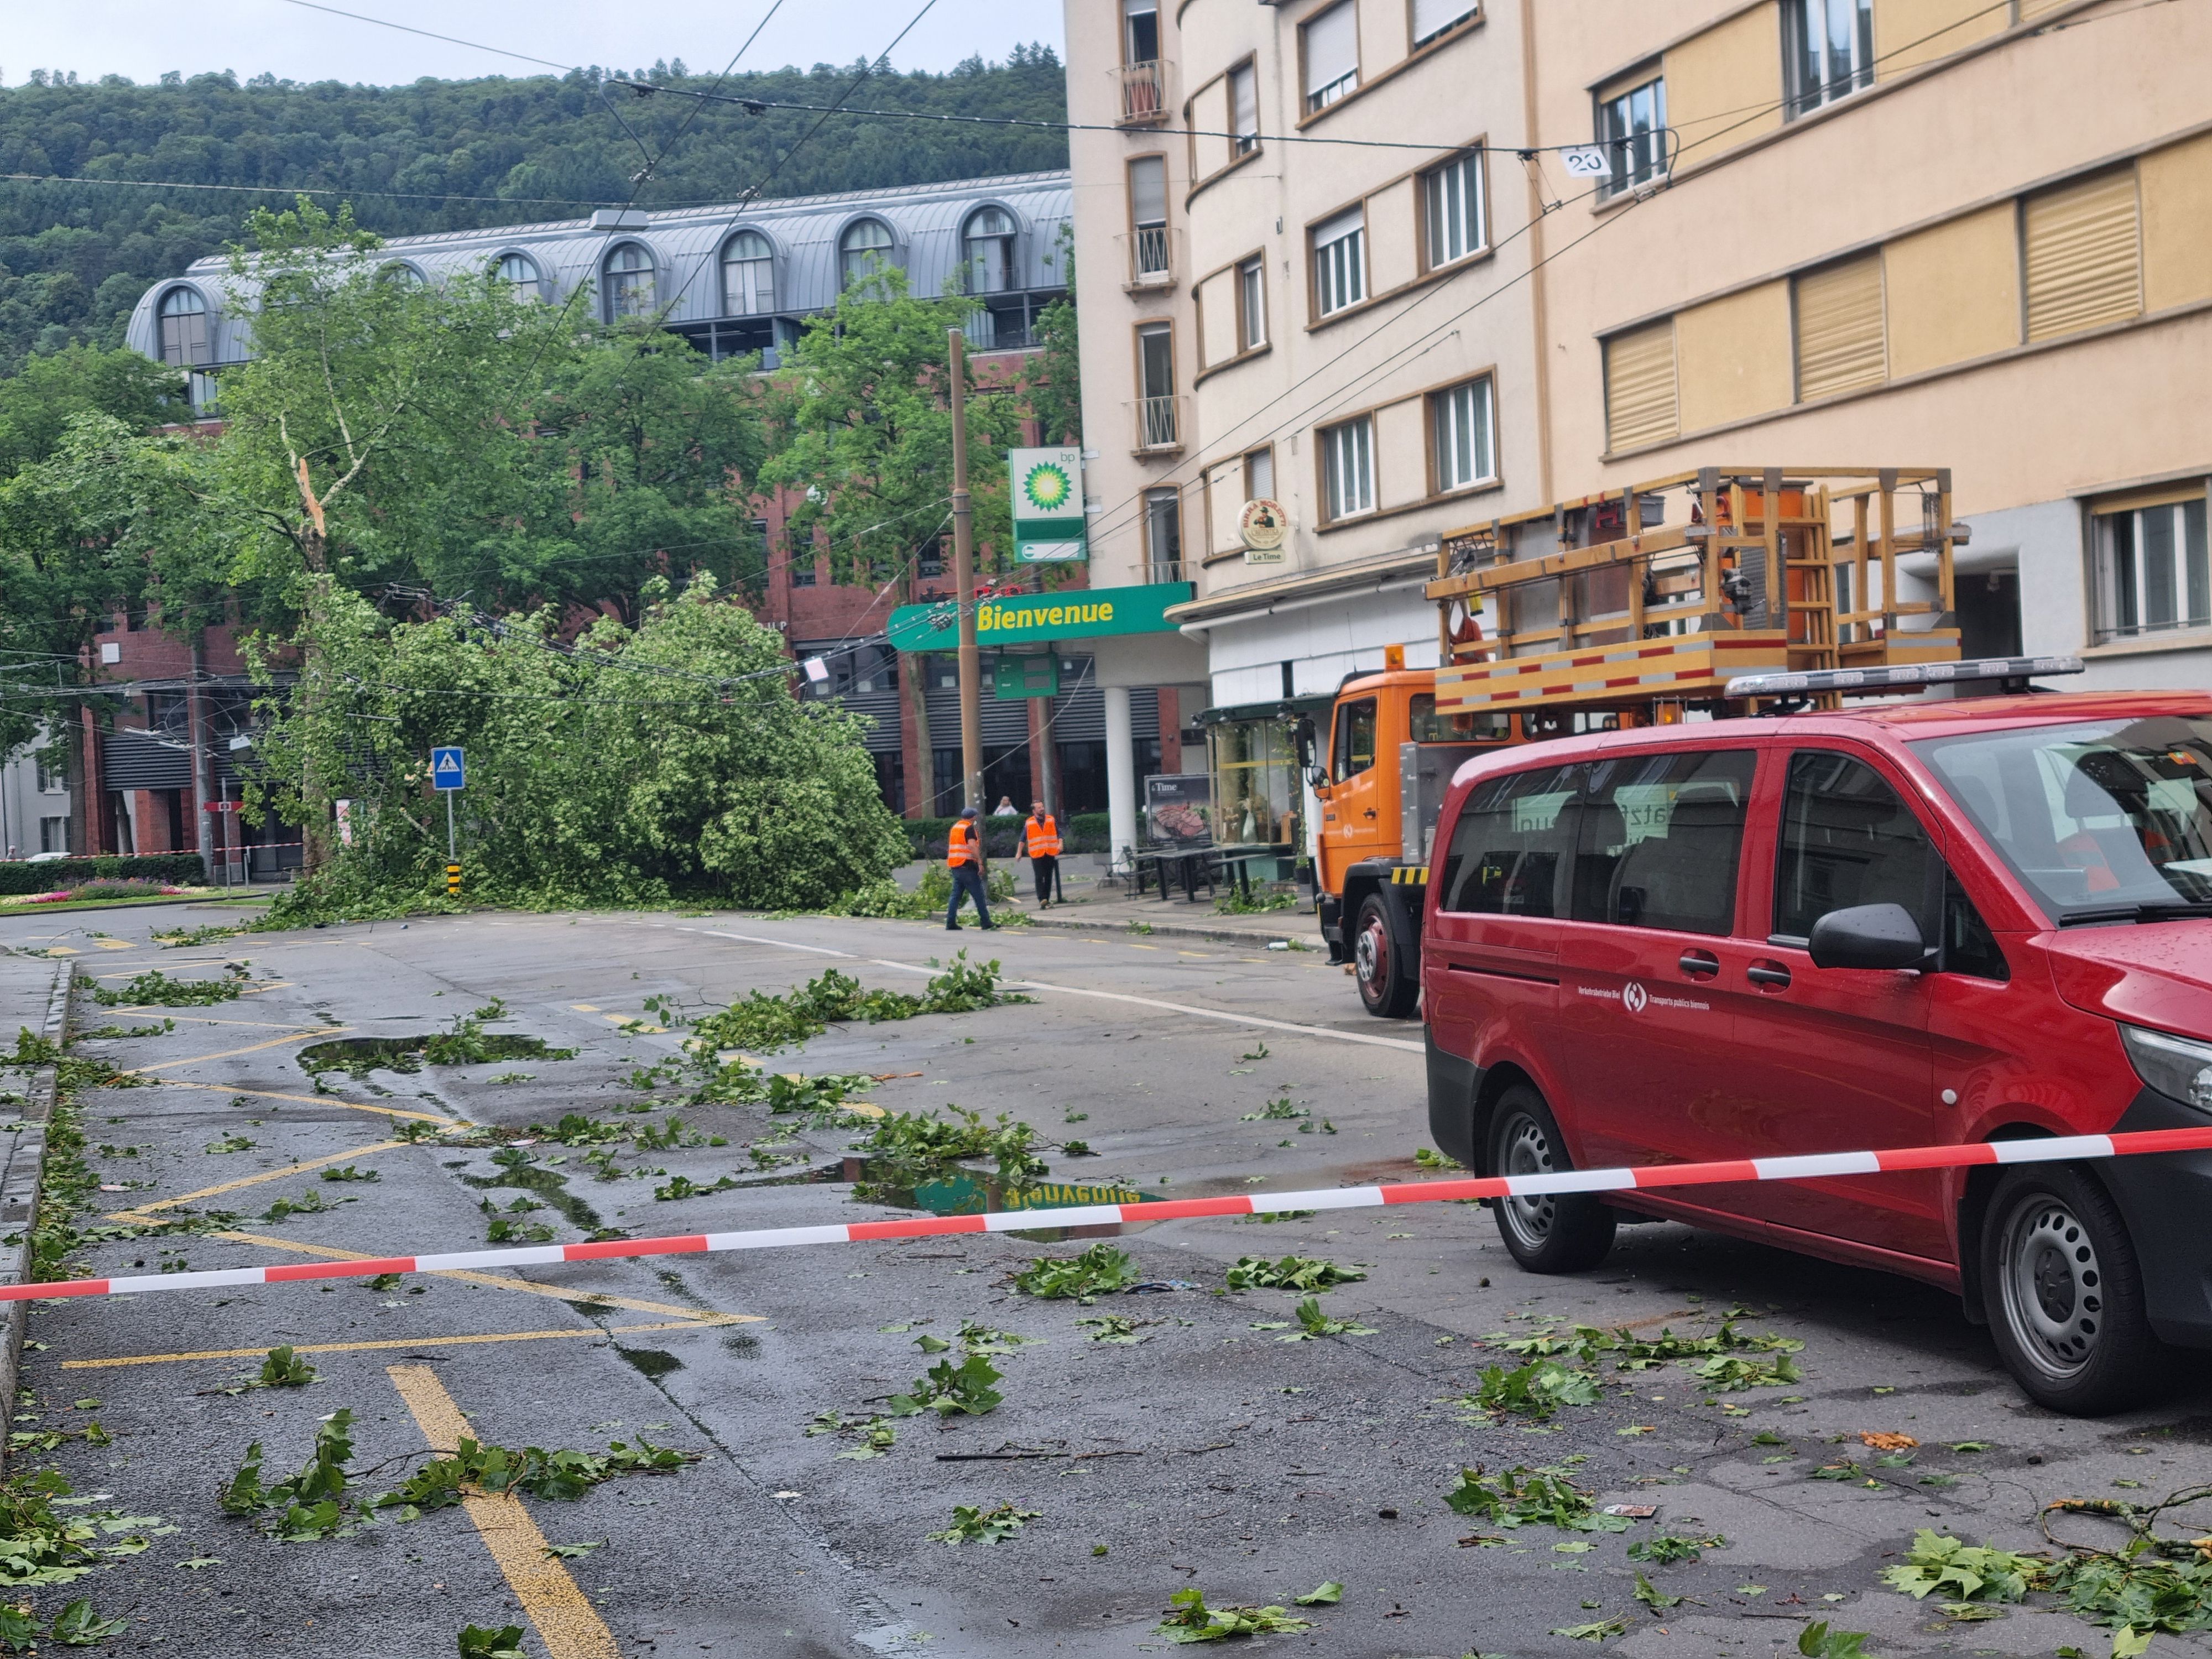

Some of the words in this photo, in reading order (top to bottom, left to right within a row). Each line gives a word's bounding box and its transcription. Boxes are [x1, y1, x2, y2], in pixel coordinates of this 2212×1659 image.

[1060, 451, 1076, 463] bp
[1260, 500, 1287, 527] MORETTI
[977, 602, 1113, 631] Bienvenue
[1155, 782, 1177, 791] Time
[1578, 986, 1612, 998] Verkehrsbetriebe
[1611, 990, 1621, 999] Biel
[1649, 994, 1673, 1005] Transports
[1673, 998, 1690, 1008] publics
[1690, 1000, 1710, 1010] biennois
